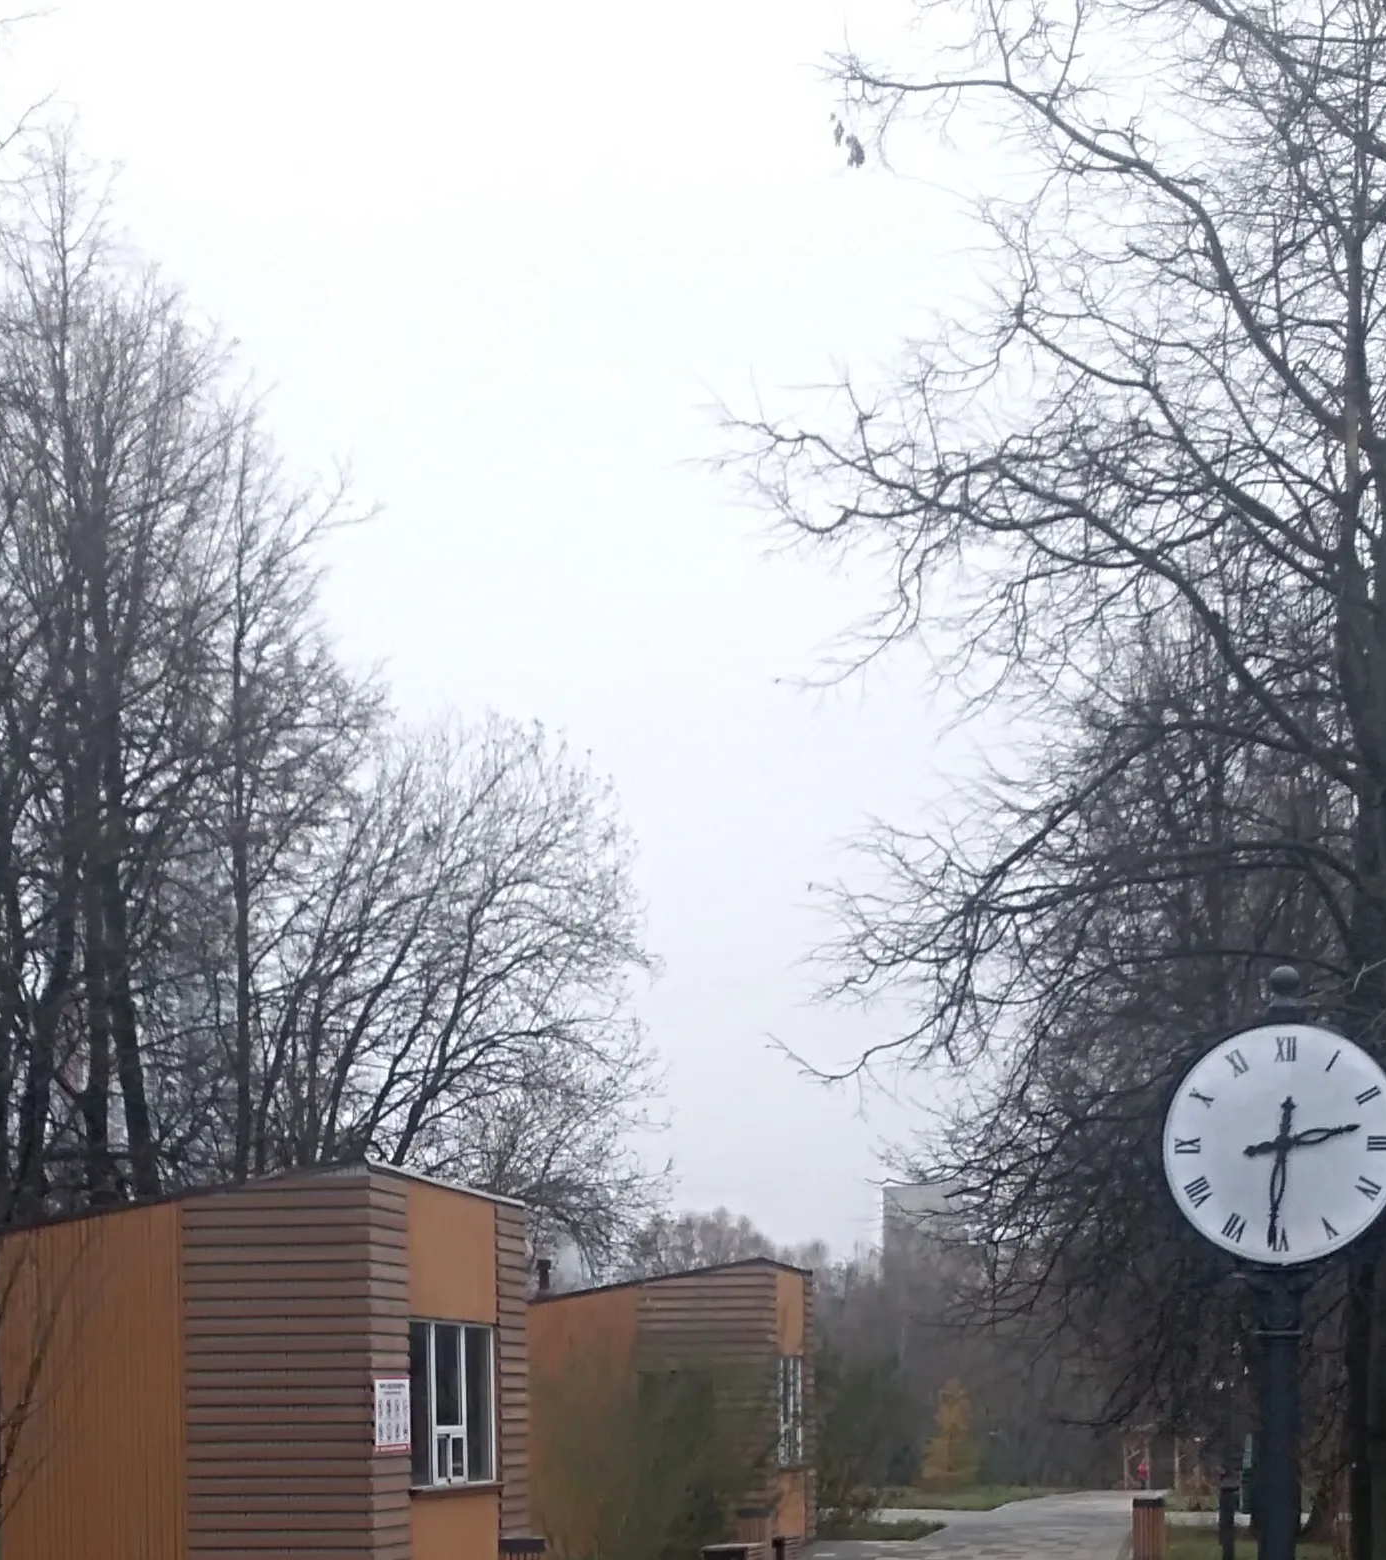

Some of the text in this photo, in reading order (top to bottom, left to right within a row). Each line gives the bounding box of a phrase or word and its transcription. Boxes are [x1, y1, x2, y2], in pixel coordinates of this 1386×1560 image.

[1274, 1036, 1297, 1062] XII
[1325, 1050, 1341, 1072] I
[1224, 1049, 1249, 1078] XI
[1189, 1087, 1214, 1109] X
[1355, 1085, 1382, 1107] II
[1174, 1137, 1201, 1155] IX
[1183, 1175, 1213, 1209] VIII
[1355, 1175, 1382, 1202] IV
[1221, 1212, 1247, 1244] VII
[1321, 1217, 1340, 1241] V
